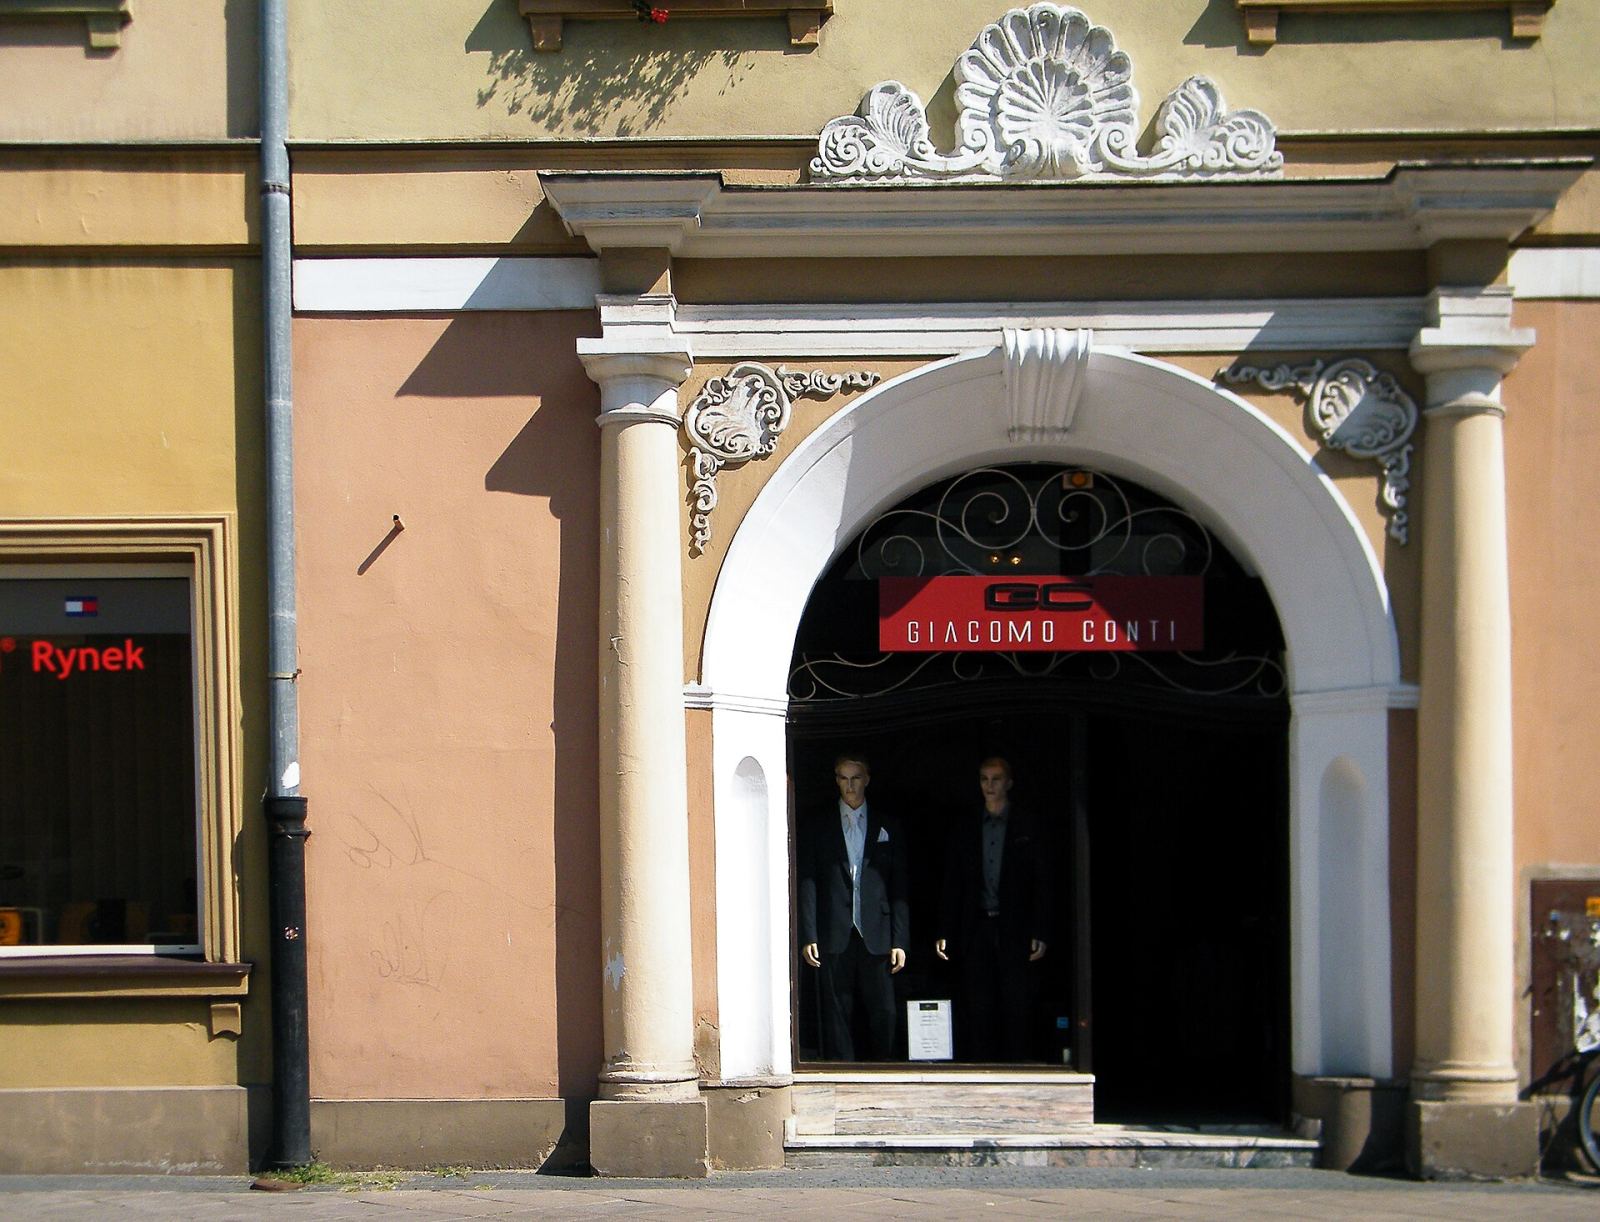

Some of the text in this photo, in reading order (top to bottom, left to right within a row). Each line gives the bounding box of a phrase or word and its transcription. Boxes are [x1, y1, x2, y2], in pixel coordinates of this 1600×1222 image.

[908, 619, 1175, 643] GIACOMO CONTI
[32, 638, 144, 679] Rynek
